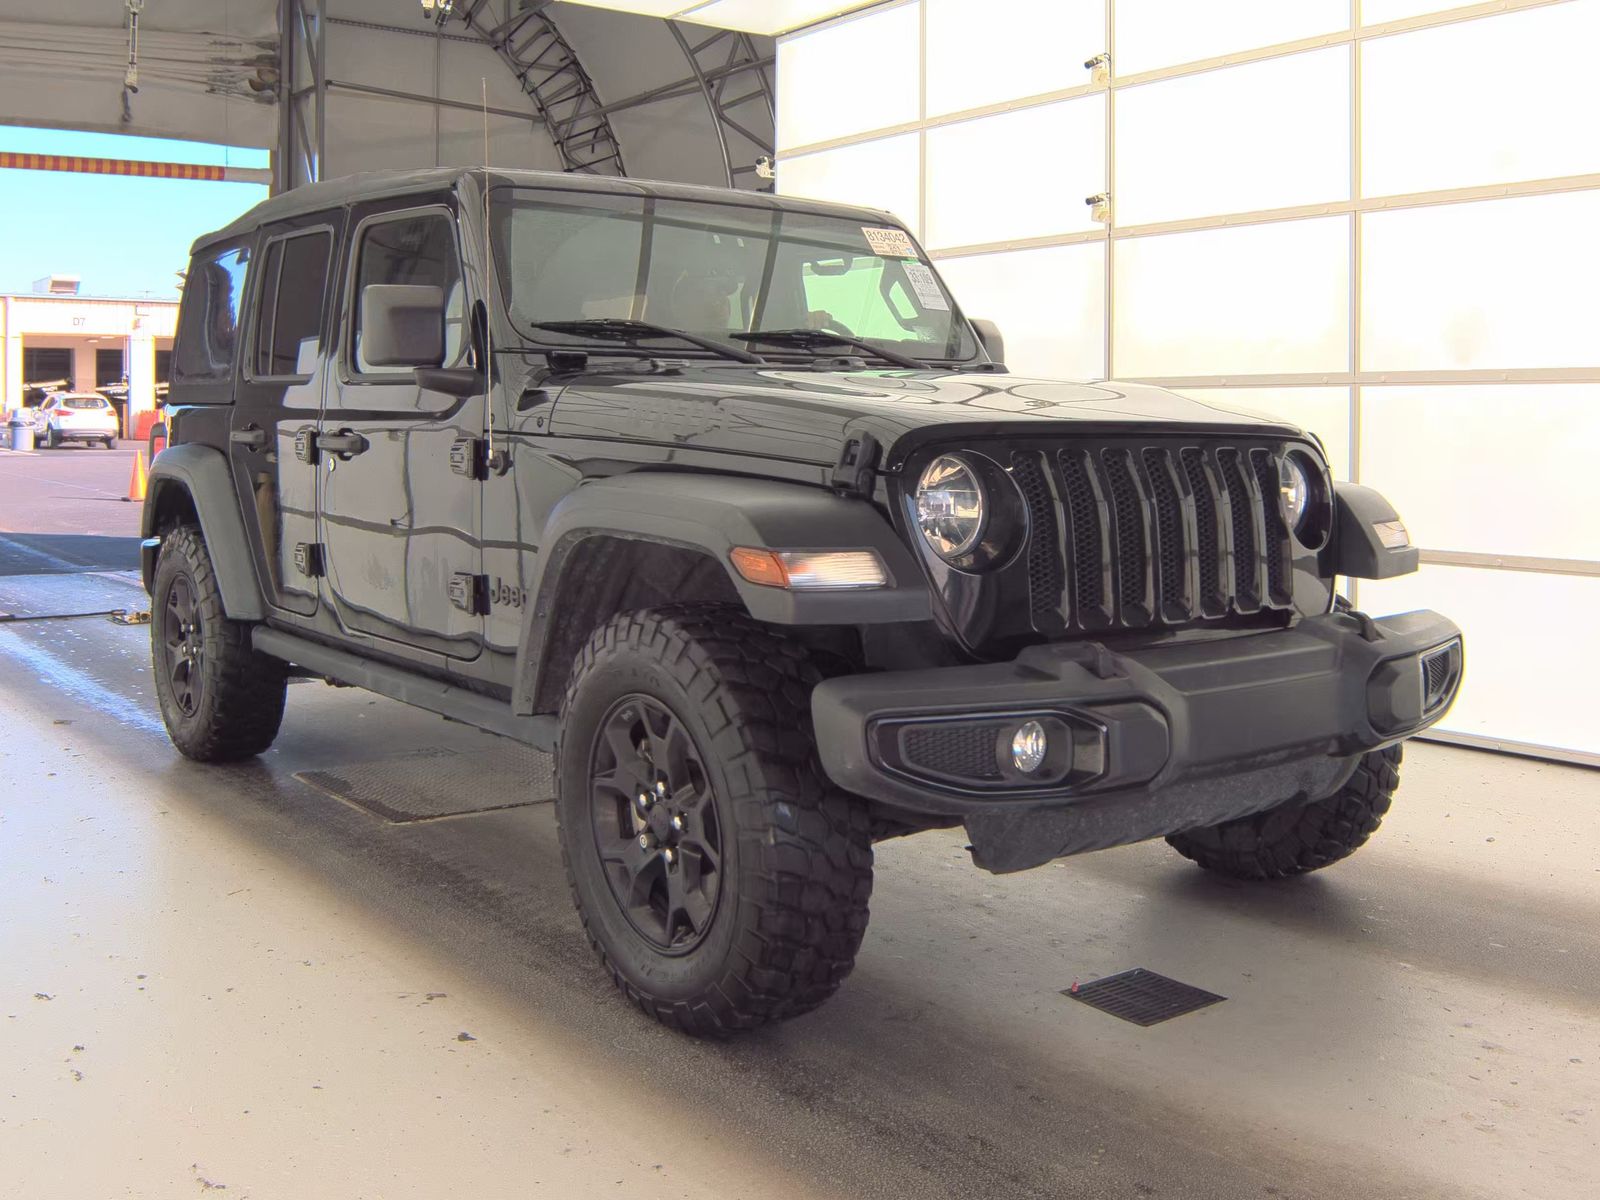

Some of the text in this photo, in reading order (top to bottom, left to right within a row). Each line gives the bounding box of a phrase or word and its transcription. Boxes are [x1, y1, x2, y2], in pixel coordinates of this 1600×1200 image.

[866, 230, 908, 244] 8134042
[72, 317, 86, 326] D7
[491, 576, 528, 615] Jeep
